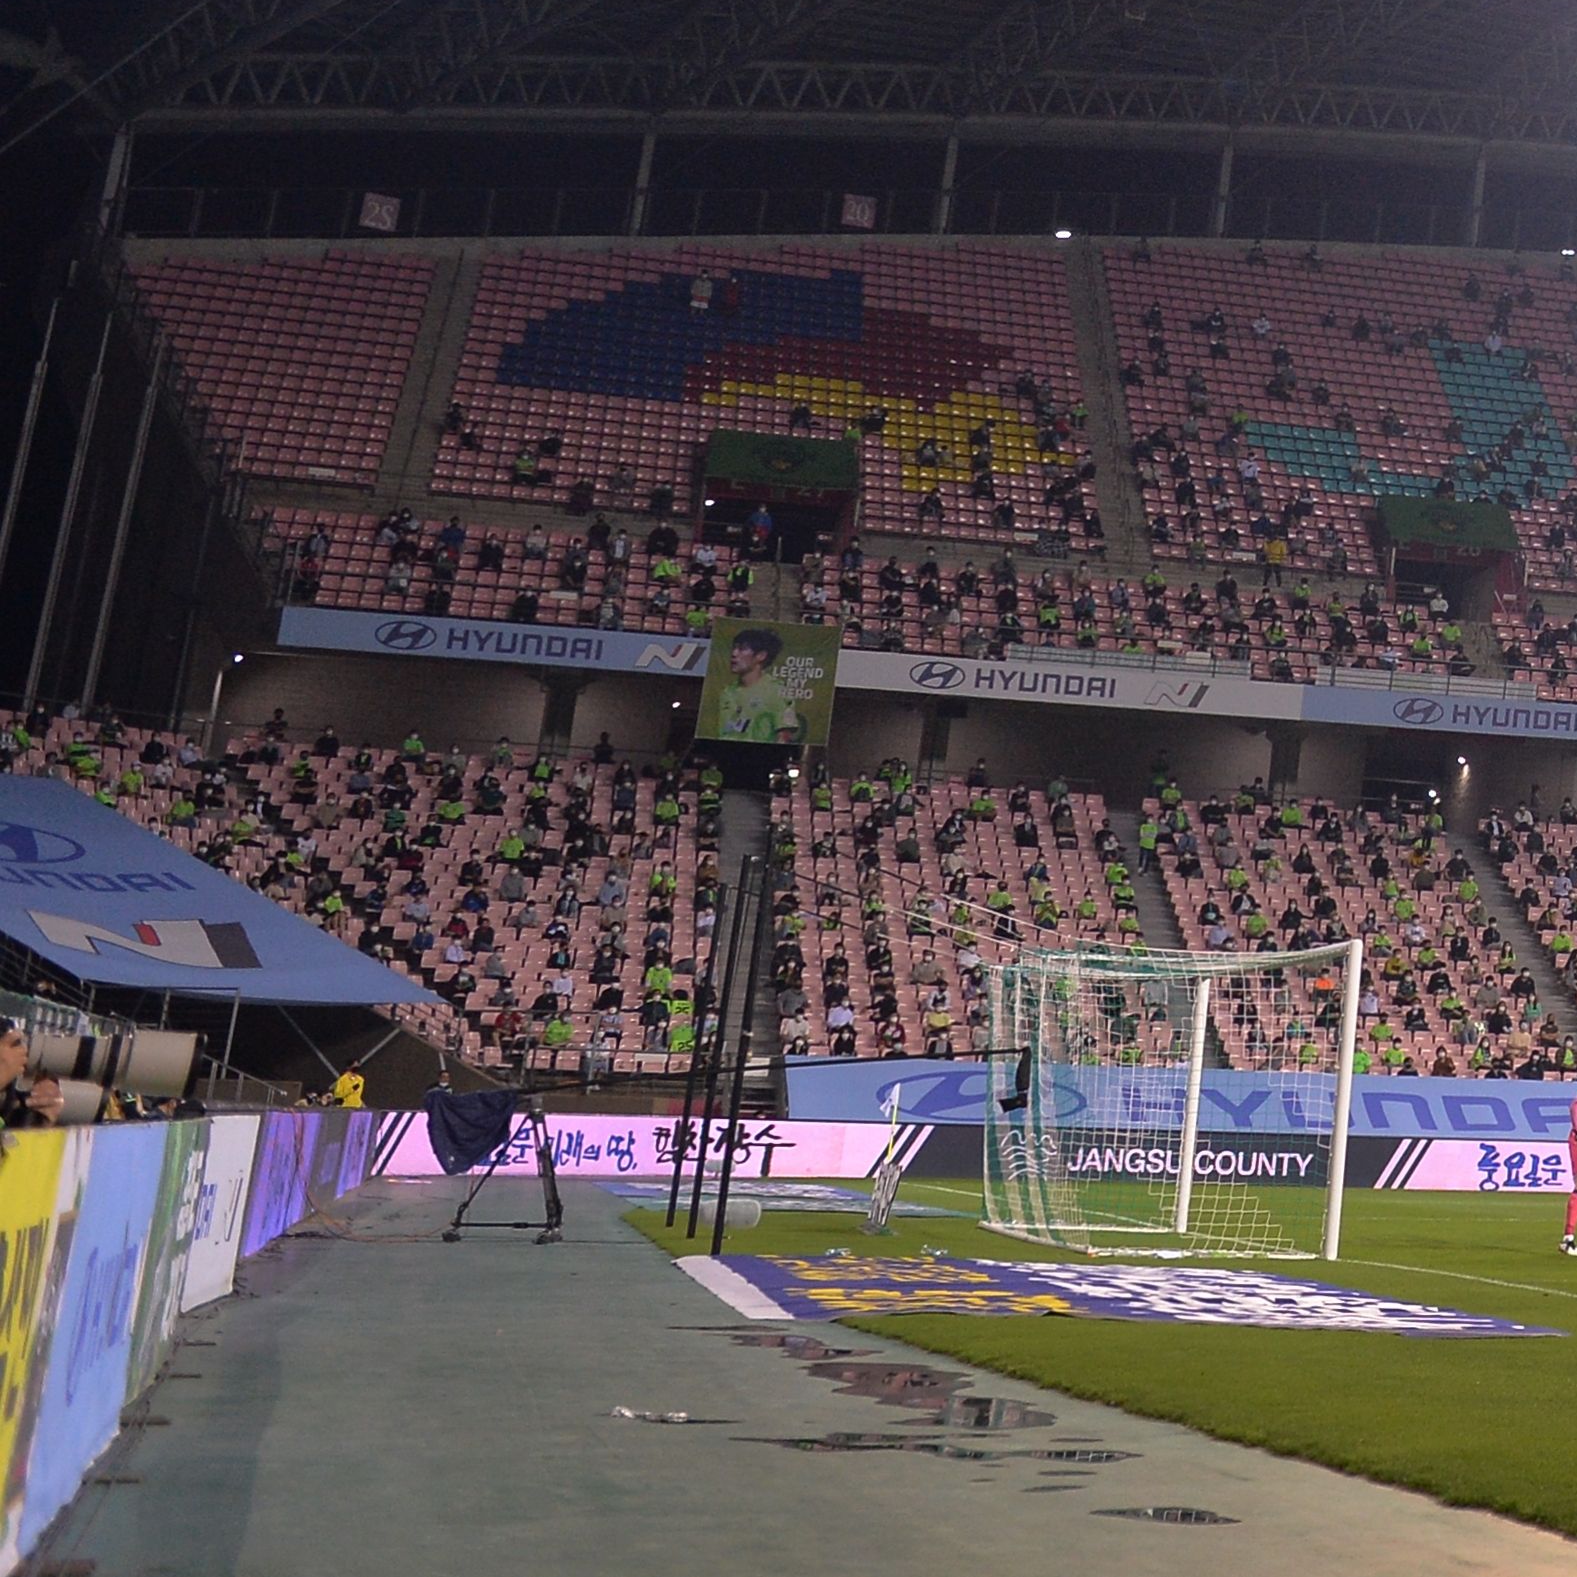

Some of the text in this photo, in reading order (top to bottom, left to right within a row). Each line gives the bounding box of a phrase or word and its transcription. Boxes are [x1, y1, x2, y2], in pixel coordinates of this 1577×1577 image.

[447, 628, 604, 661] HYUNDAI
[772, 666, 824, 679] LEGEND
[785, 656, 814, 667] OUR
[786, 678, 807, 689] MY
[974, 667, 1116, 699] HYUNDAI
[1067, 1145, 1314, 1178] JANGSU COUNTY
